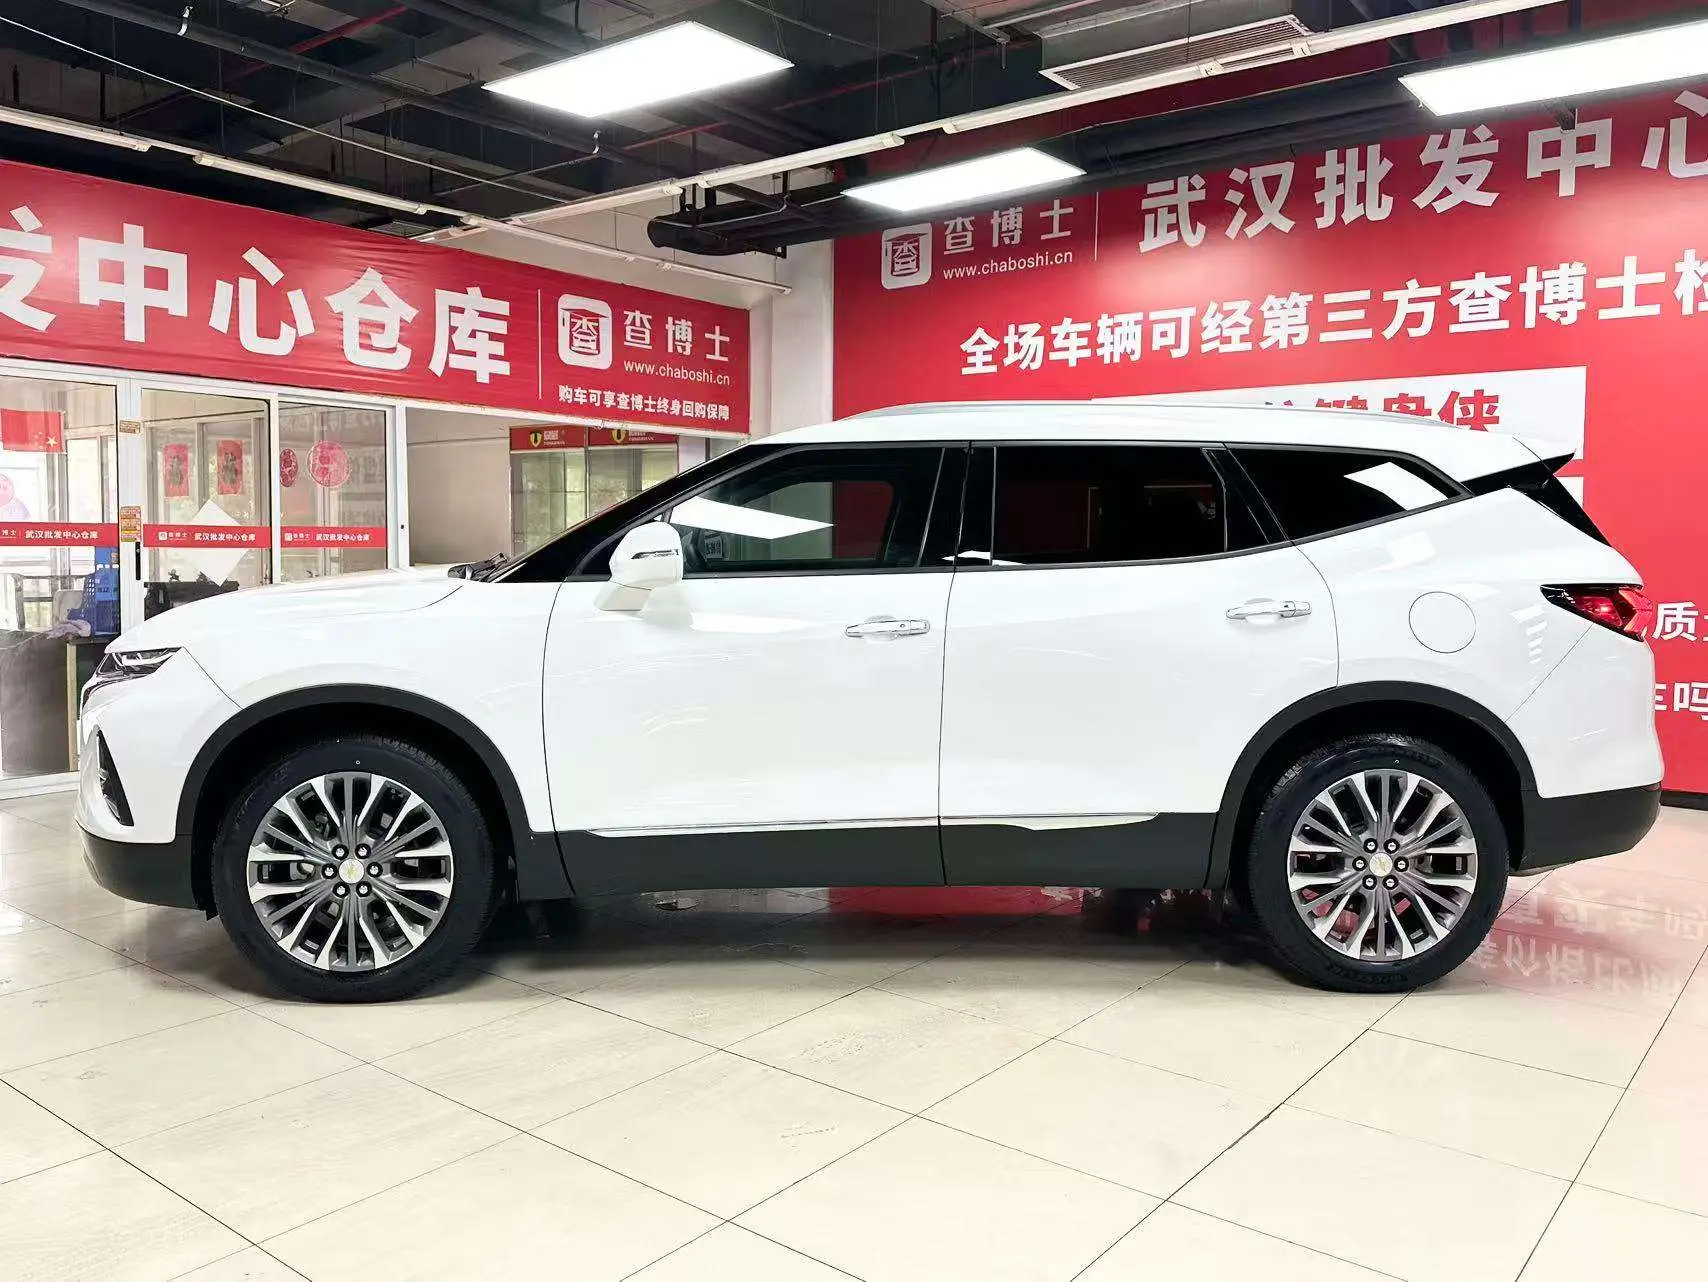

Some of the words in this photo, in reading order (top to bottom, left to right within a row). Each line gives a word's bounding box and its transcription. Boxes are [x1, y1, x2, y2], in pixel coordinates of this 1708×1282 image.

[943, 199, 1074, 255] 查博士
[943, 251, 1073, 280] www.chaboshi.cn
[623, 310, 730, 362] 查博士
[623, 359, 730, 386] www.chaboshi.cn
[558, 384, 730, 421] 购车可享查博士终身回购保障
[1652, 600, 1708, 642] 质
